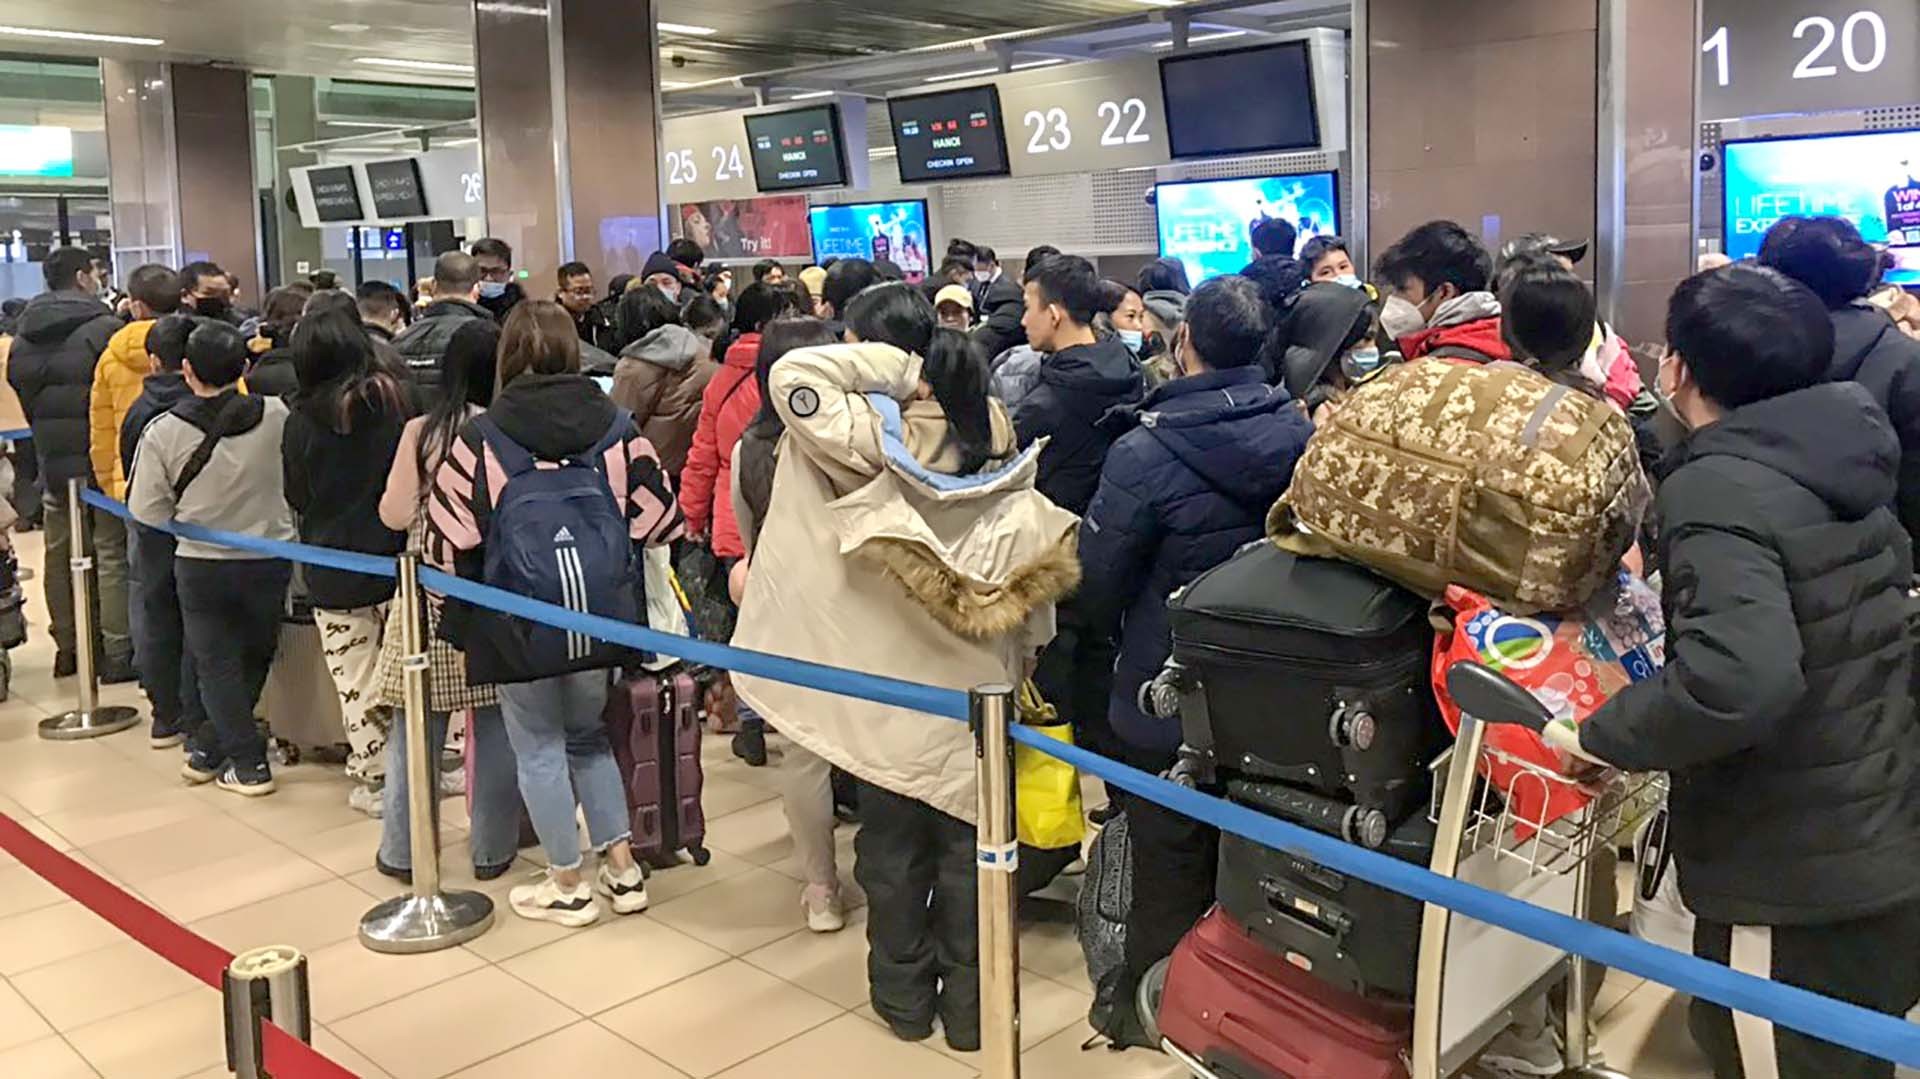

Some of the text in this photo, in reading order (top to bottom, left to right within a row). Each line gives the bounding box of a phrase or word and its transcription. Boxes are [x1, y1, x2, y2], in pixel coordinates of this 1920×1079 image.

[1702, 10, 1887, 86] 1 20
[1024, 98, 1150, 153] 23 22
[932, 136, 961, 149] HANOI
[665, 144, 744, 185] 25 24
[1735, 218, 1776, 234] EXP
[740, 237, 759, 252] Try
